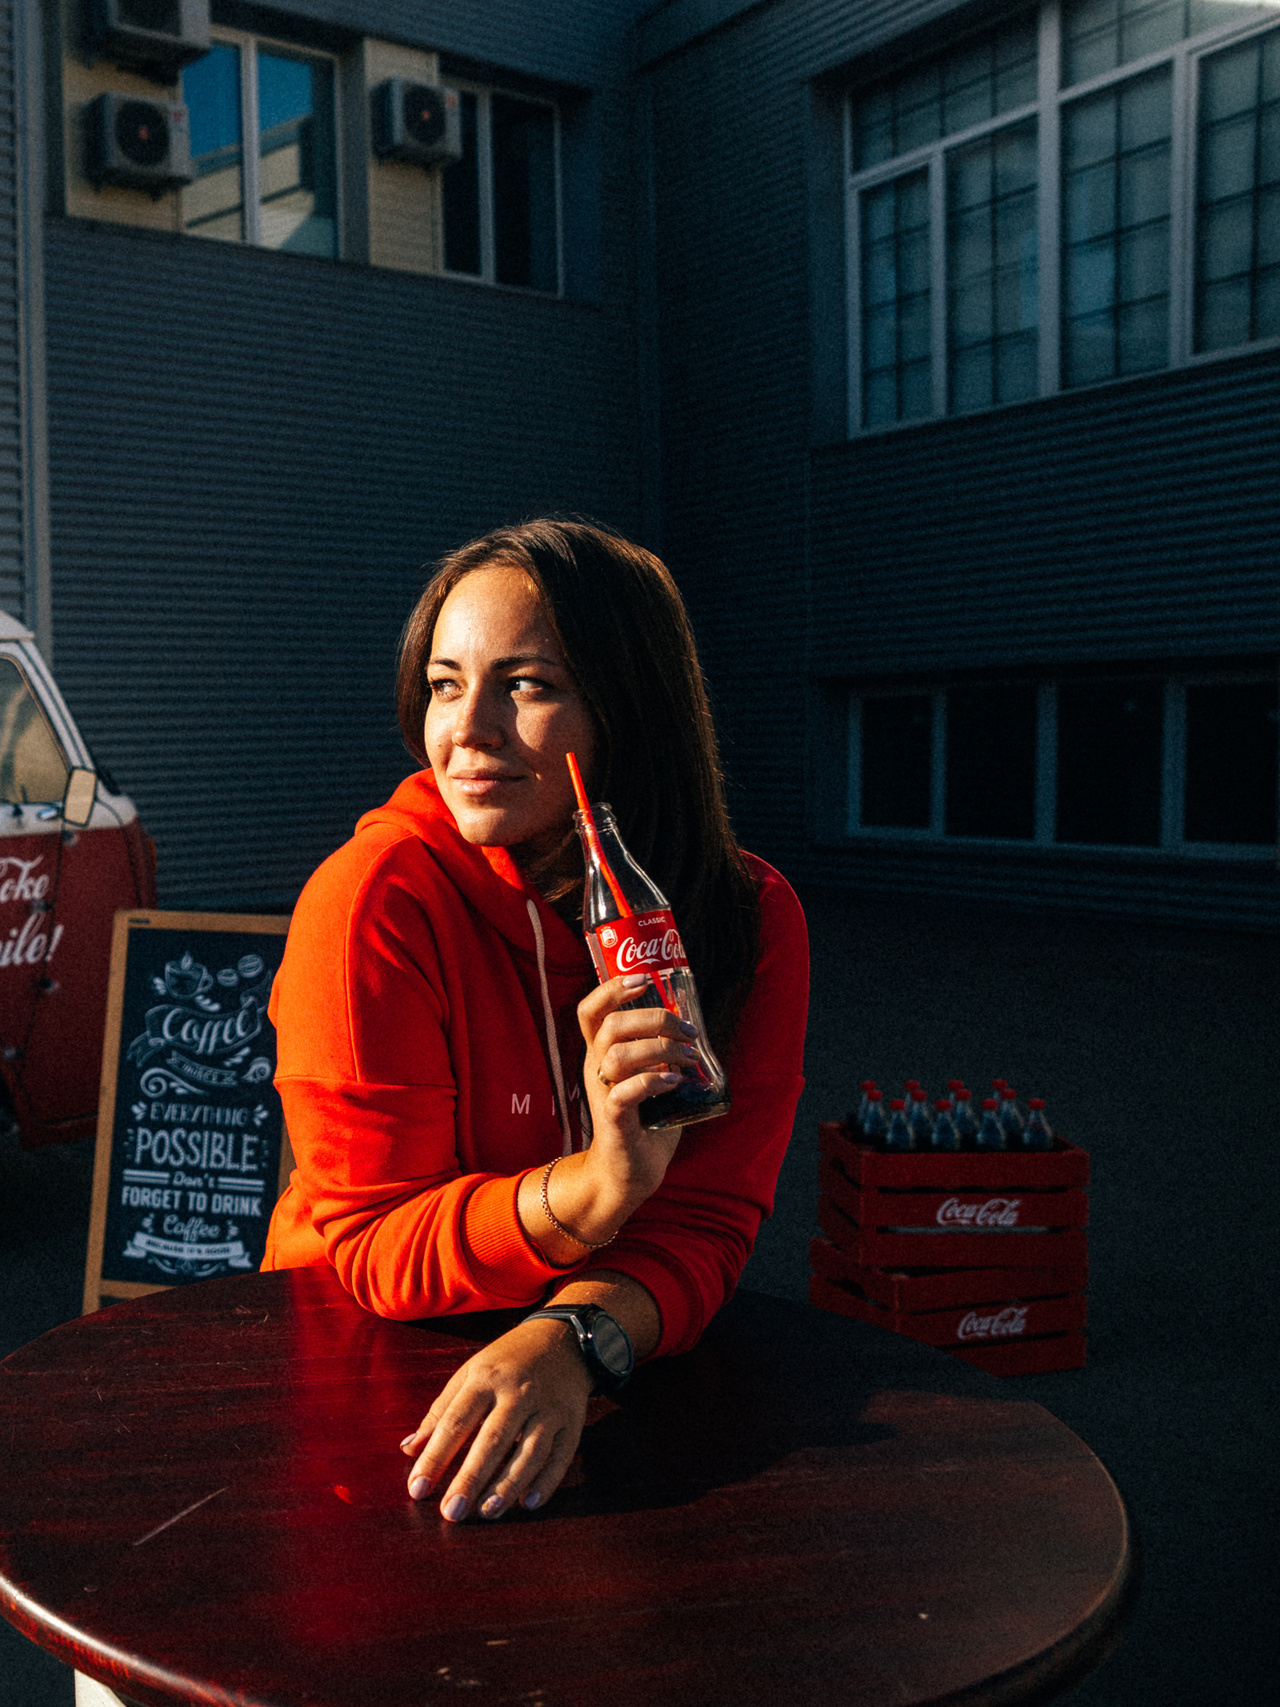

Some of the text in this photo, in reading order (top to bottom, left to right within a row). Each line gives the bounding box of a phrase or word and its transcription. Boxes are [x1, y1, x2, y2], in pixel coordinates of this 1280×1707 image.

[638, 916, 666, 927] CLASSIC
[134, 1127, 260, 1172] POSSIBLE
[172, 1170, 215, 1188] Don't
[122, 1185, 262, 1218] FORGET TO DRINK
[936, 1198, 1022, 1226] Coca-Cola
[163, 1214, 221, 1242] Coffee
[957, 1307, 1030, 1340] Coca-Cola
